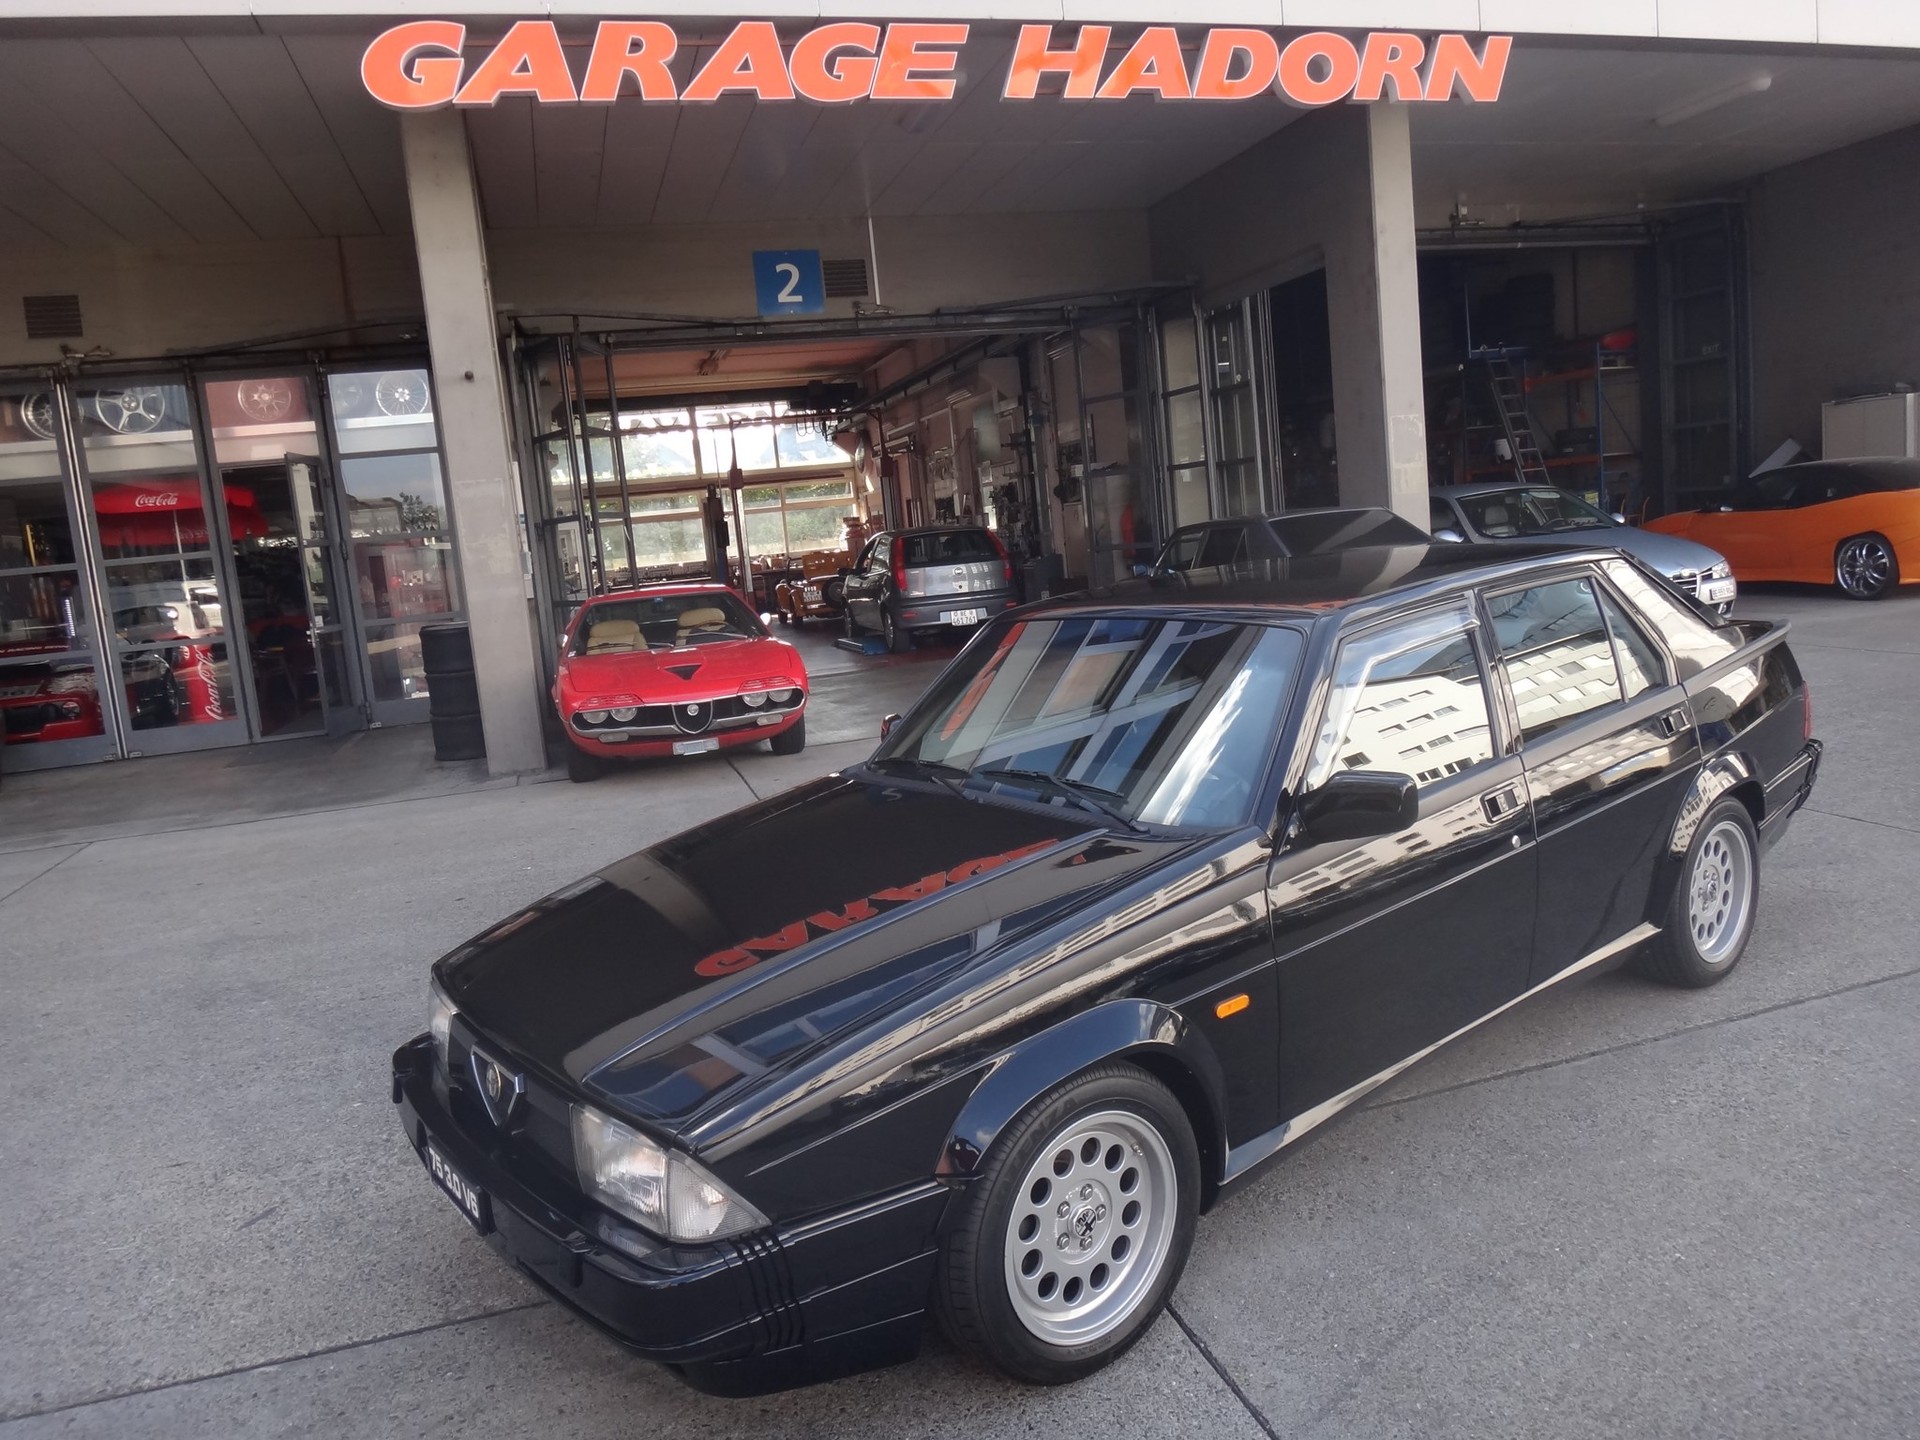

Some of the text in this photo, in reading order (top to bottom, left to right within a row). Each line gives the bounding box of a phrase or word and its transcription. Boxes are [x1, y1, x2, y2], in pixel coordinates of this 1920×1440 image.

[360, 20, 1515, 109] GARAGE HADORN
[775, 262, 803, 303] 2
[429, 1147, 443, 1179] 75
[462, 1182, 479, 1219] V6
